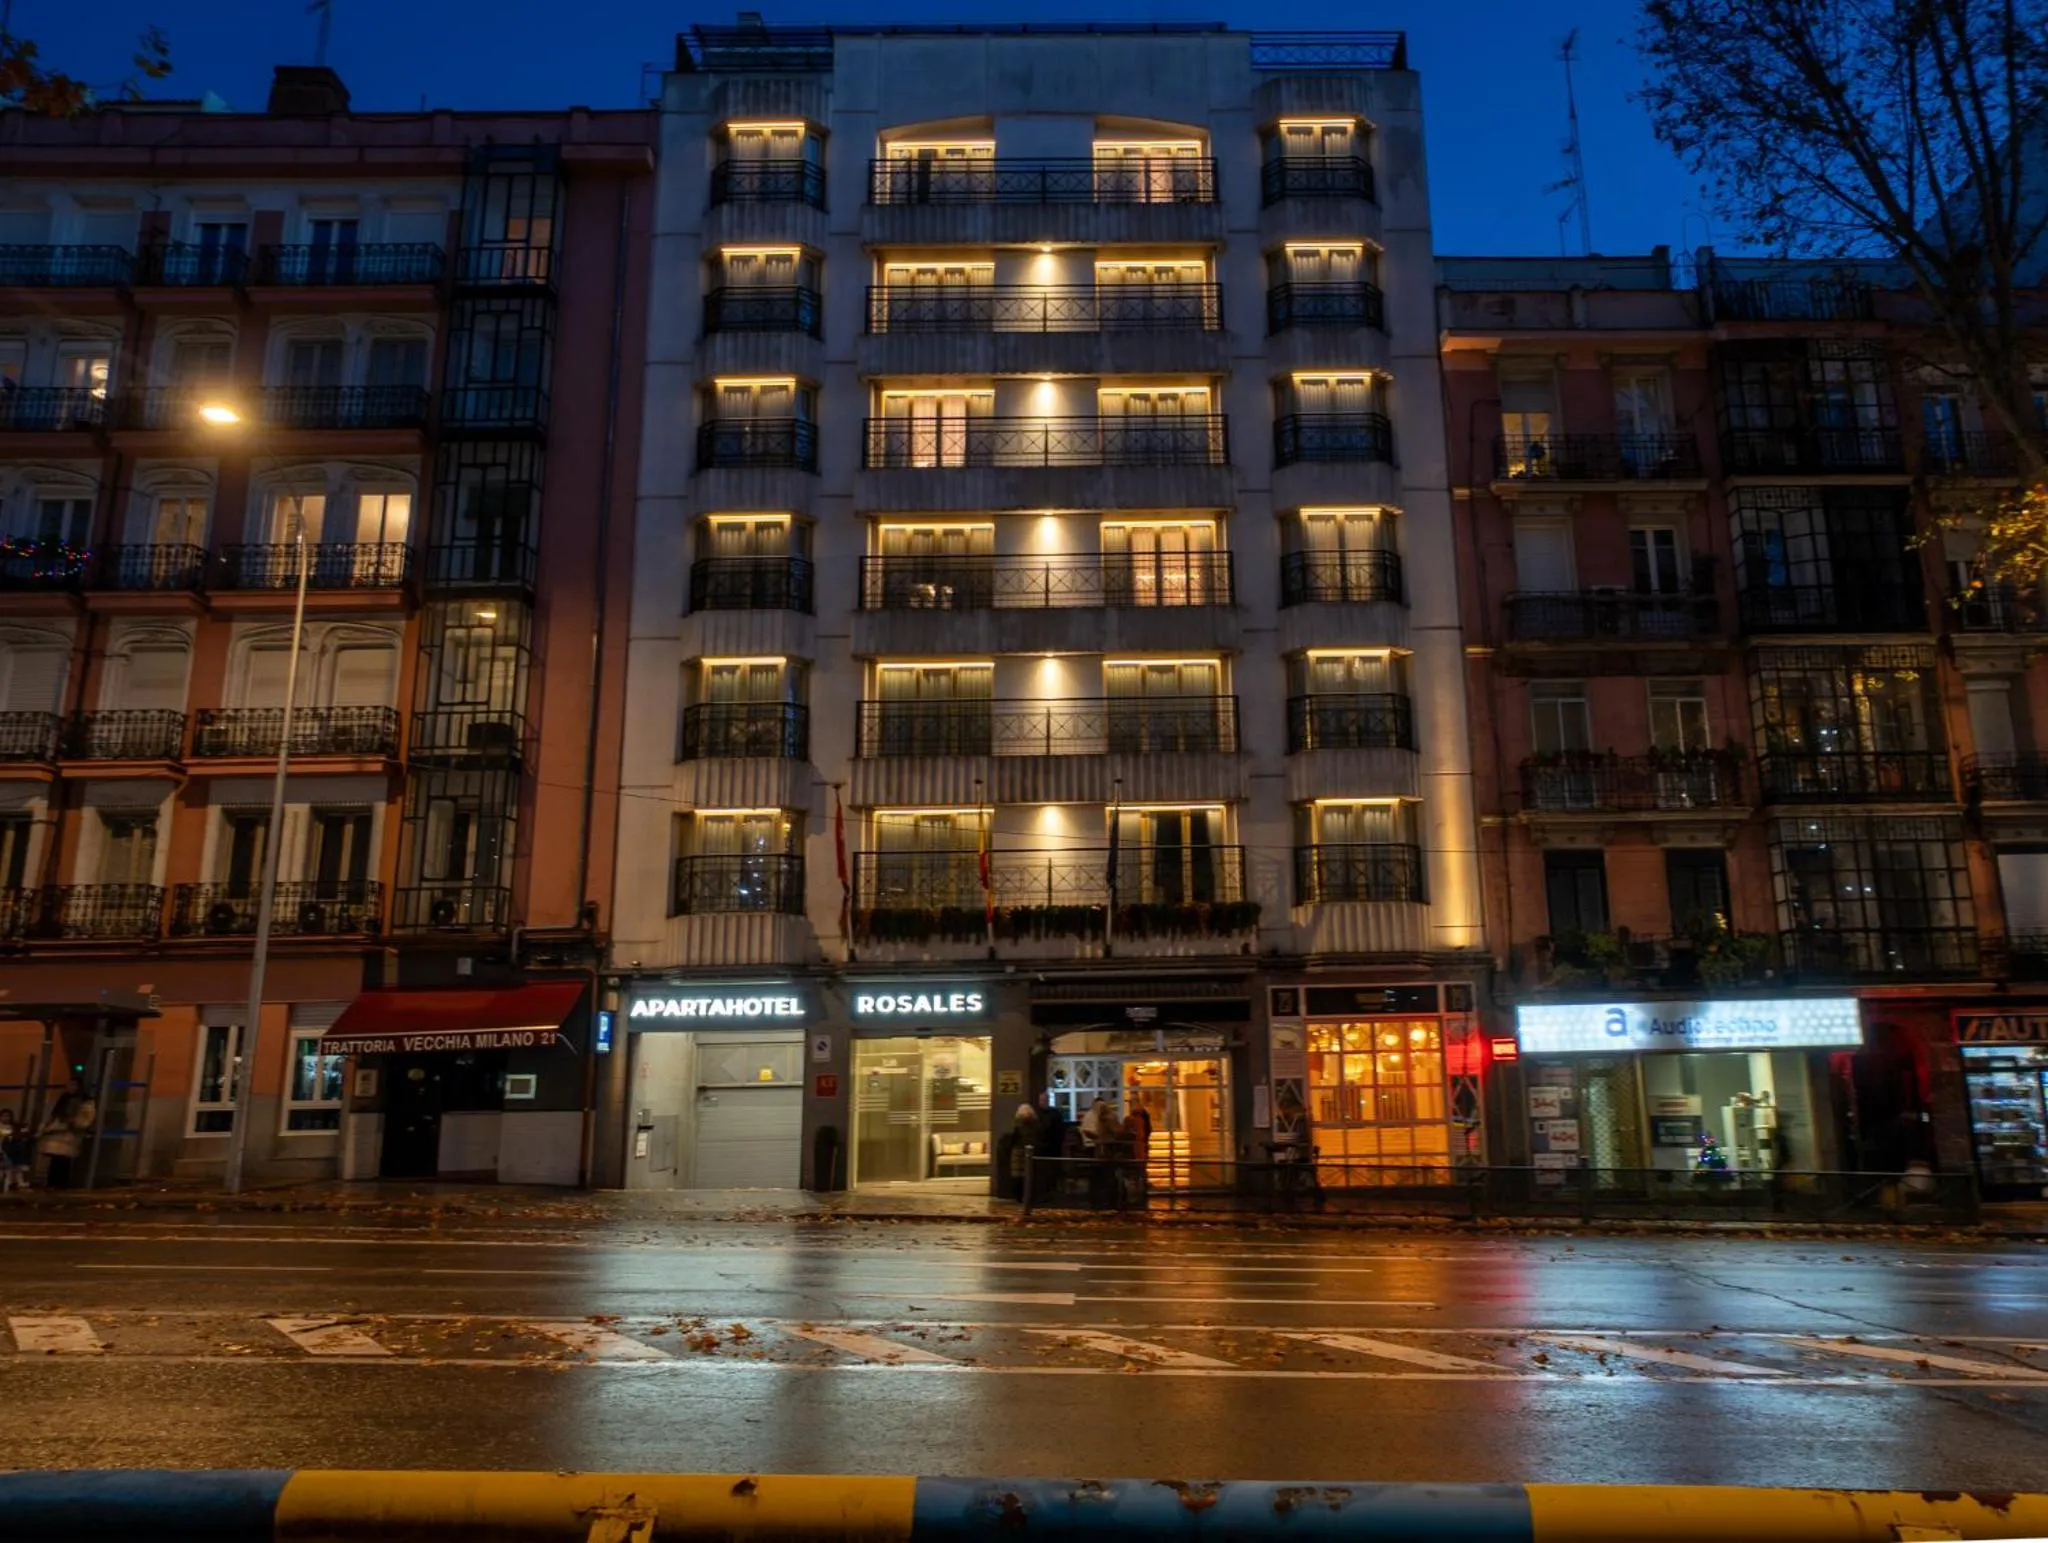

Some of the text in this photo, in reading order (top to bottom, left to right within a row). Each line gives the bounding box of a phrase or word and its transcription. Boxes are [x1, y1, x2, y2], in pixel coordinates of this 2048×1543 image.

[630, 998, 805, 1017] APARTAHOTEL
[857, 994, 983, 1013] ROSALES
[599, 1015, 609, 1040] P
[1605, 1007, 1628, 1037] a
[1650, 1016, 1777, 1036] Audioechno
[323, 1031, 556, 1054] TRATTORIA VECCHIA MILANO 21
[1000, 1082, 1020, 1094] 23
